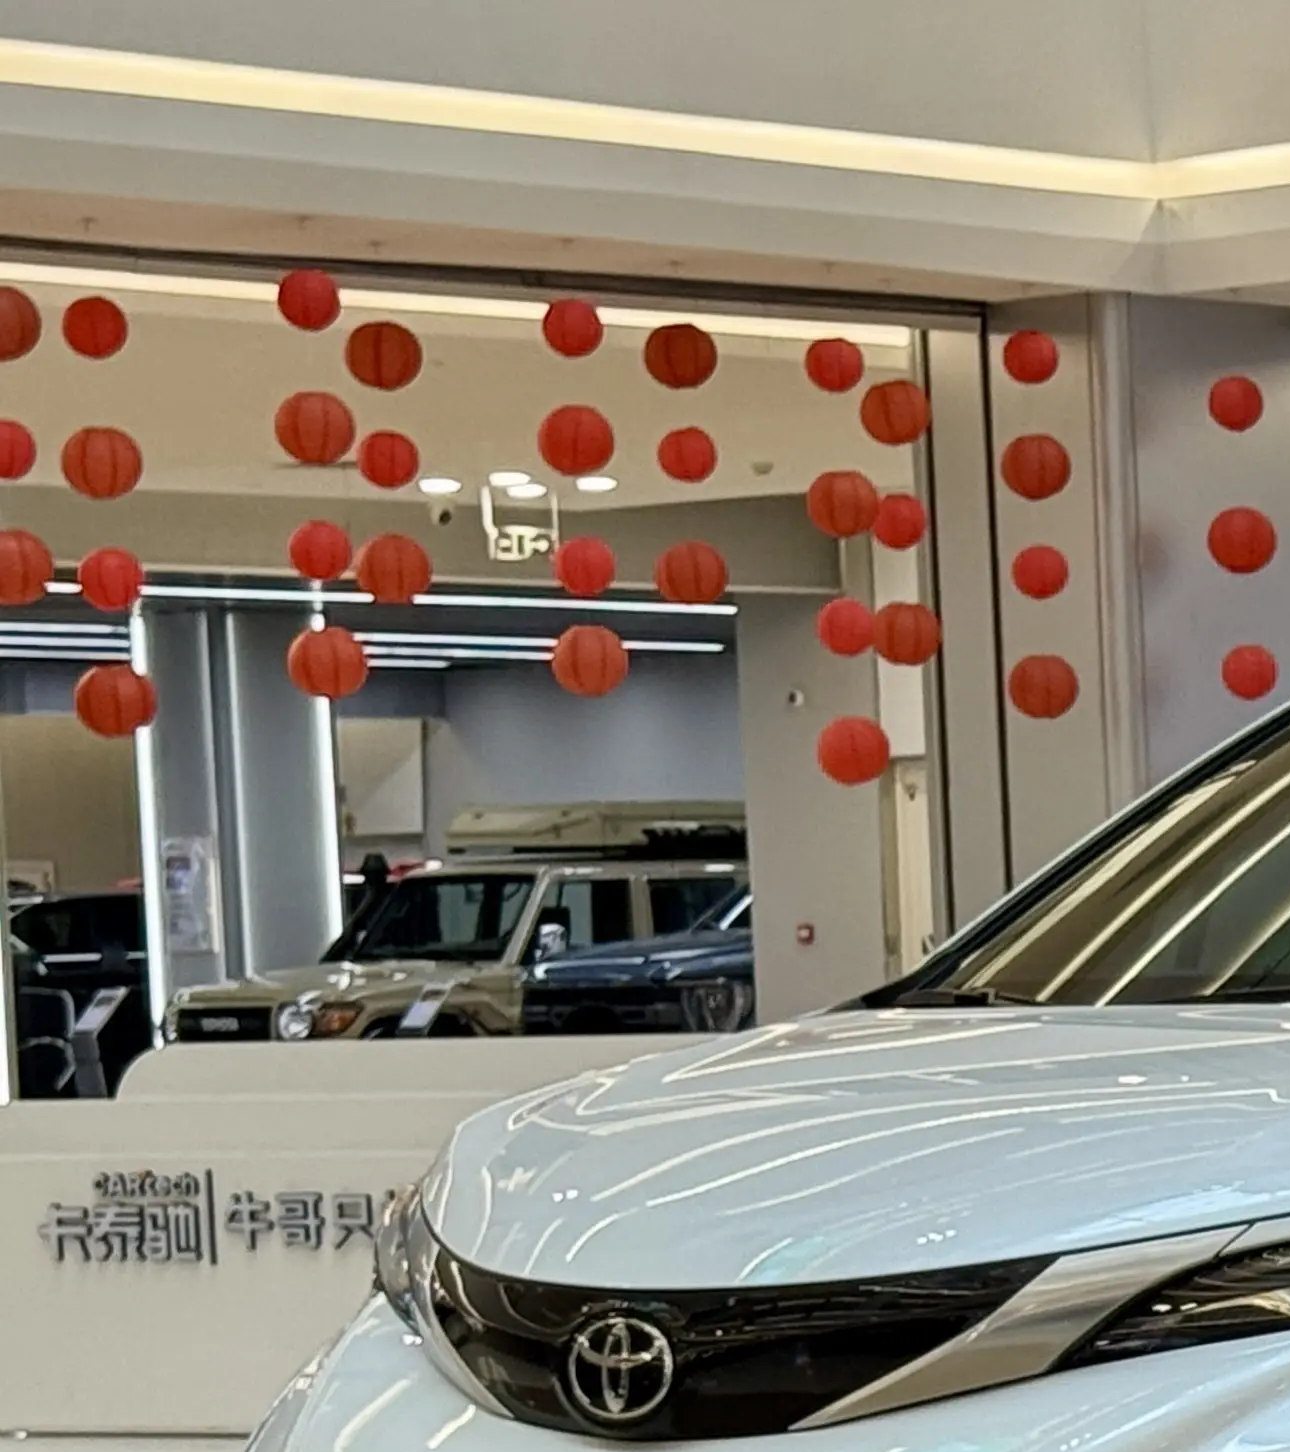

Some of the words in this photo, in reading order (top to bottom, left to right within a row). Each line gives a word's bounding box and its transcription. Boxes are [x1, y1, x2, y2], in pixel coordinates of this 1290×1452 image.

[38, 1201, 203, 1263] 卡泰驰
[224, 1189, 396, 1251] 牛哥只
